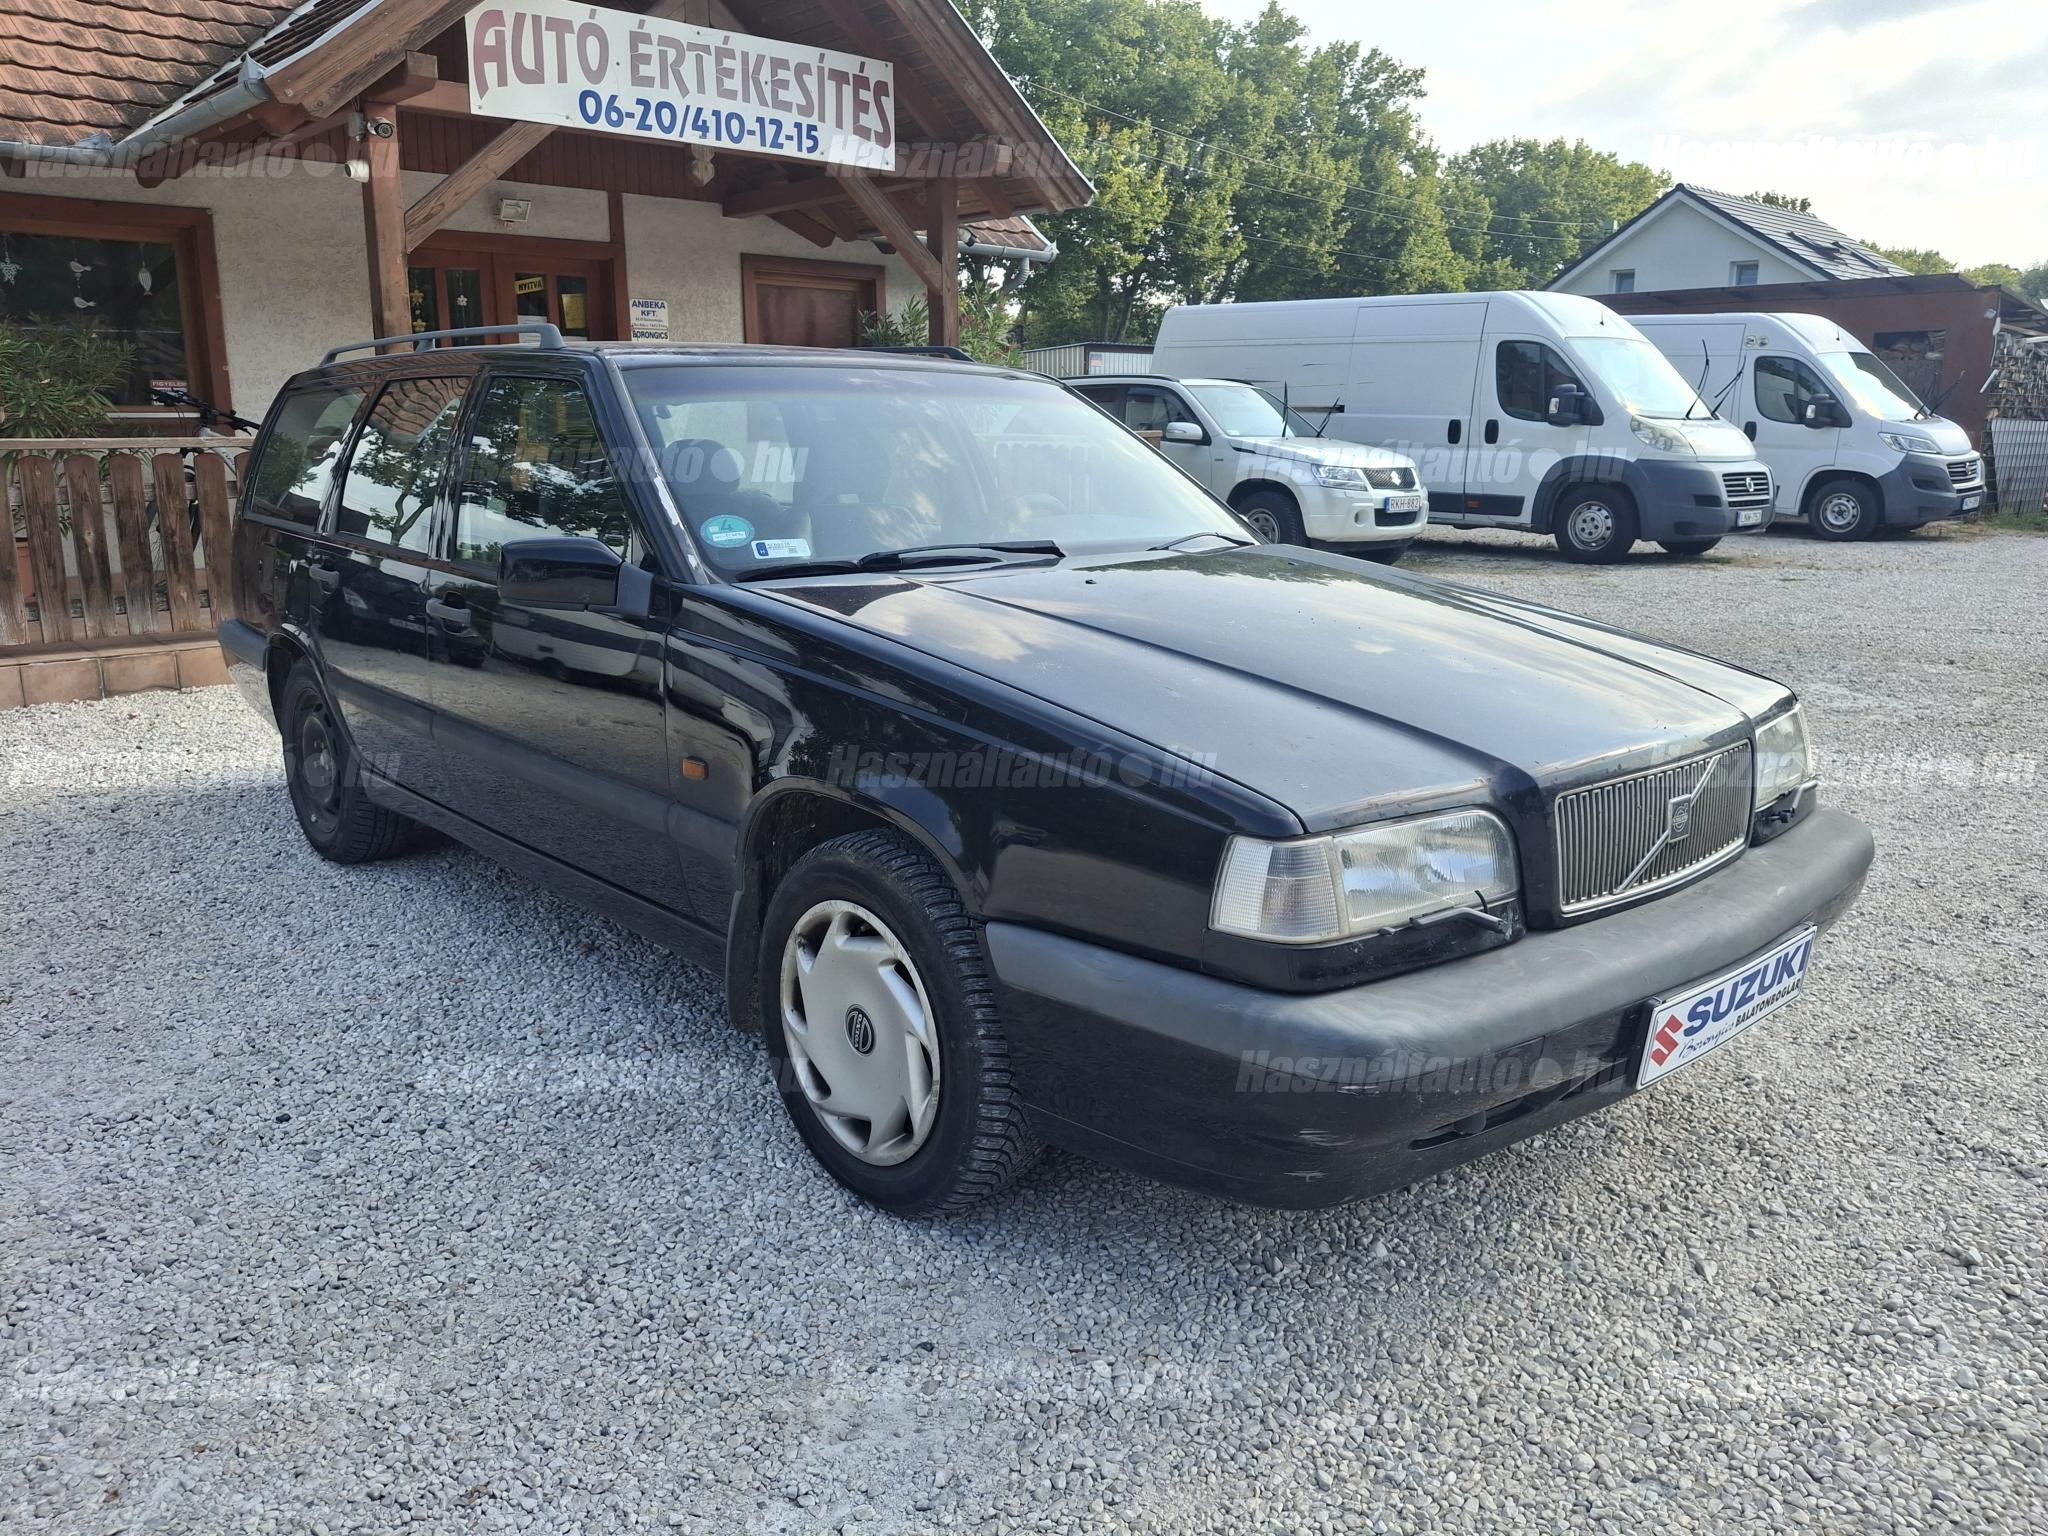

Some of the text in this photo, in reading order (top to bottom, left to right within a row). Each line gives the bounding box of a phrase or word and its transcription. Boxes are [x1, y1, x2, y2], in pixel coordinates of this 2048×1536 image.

[472, 8, 892, 150] AUTÓ ÉRTÉKESÍTÉS
[578, 89, 820, 155] 06-20/410-12-15
[518, 279, 543, 291] NYITVA
[632, 300, 666, 309] ANBEKA
[632, 330, 669, 340] BORONGICS
[1391, 498, 1419, 510] RKH-882
[721, 518, 734, 532] 4
[1683, 939, 1813, 1038] SUZUKI
